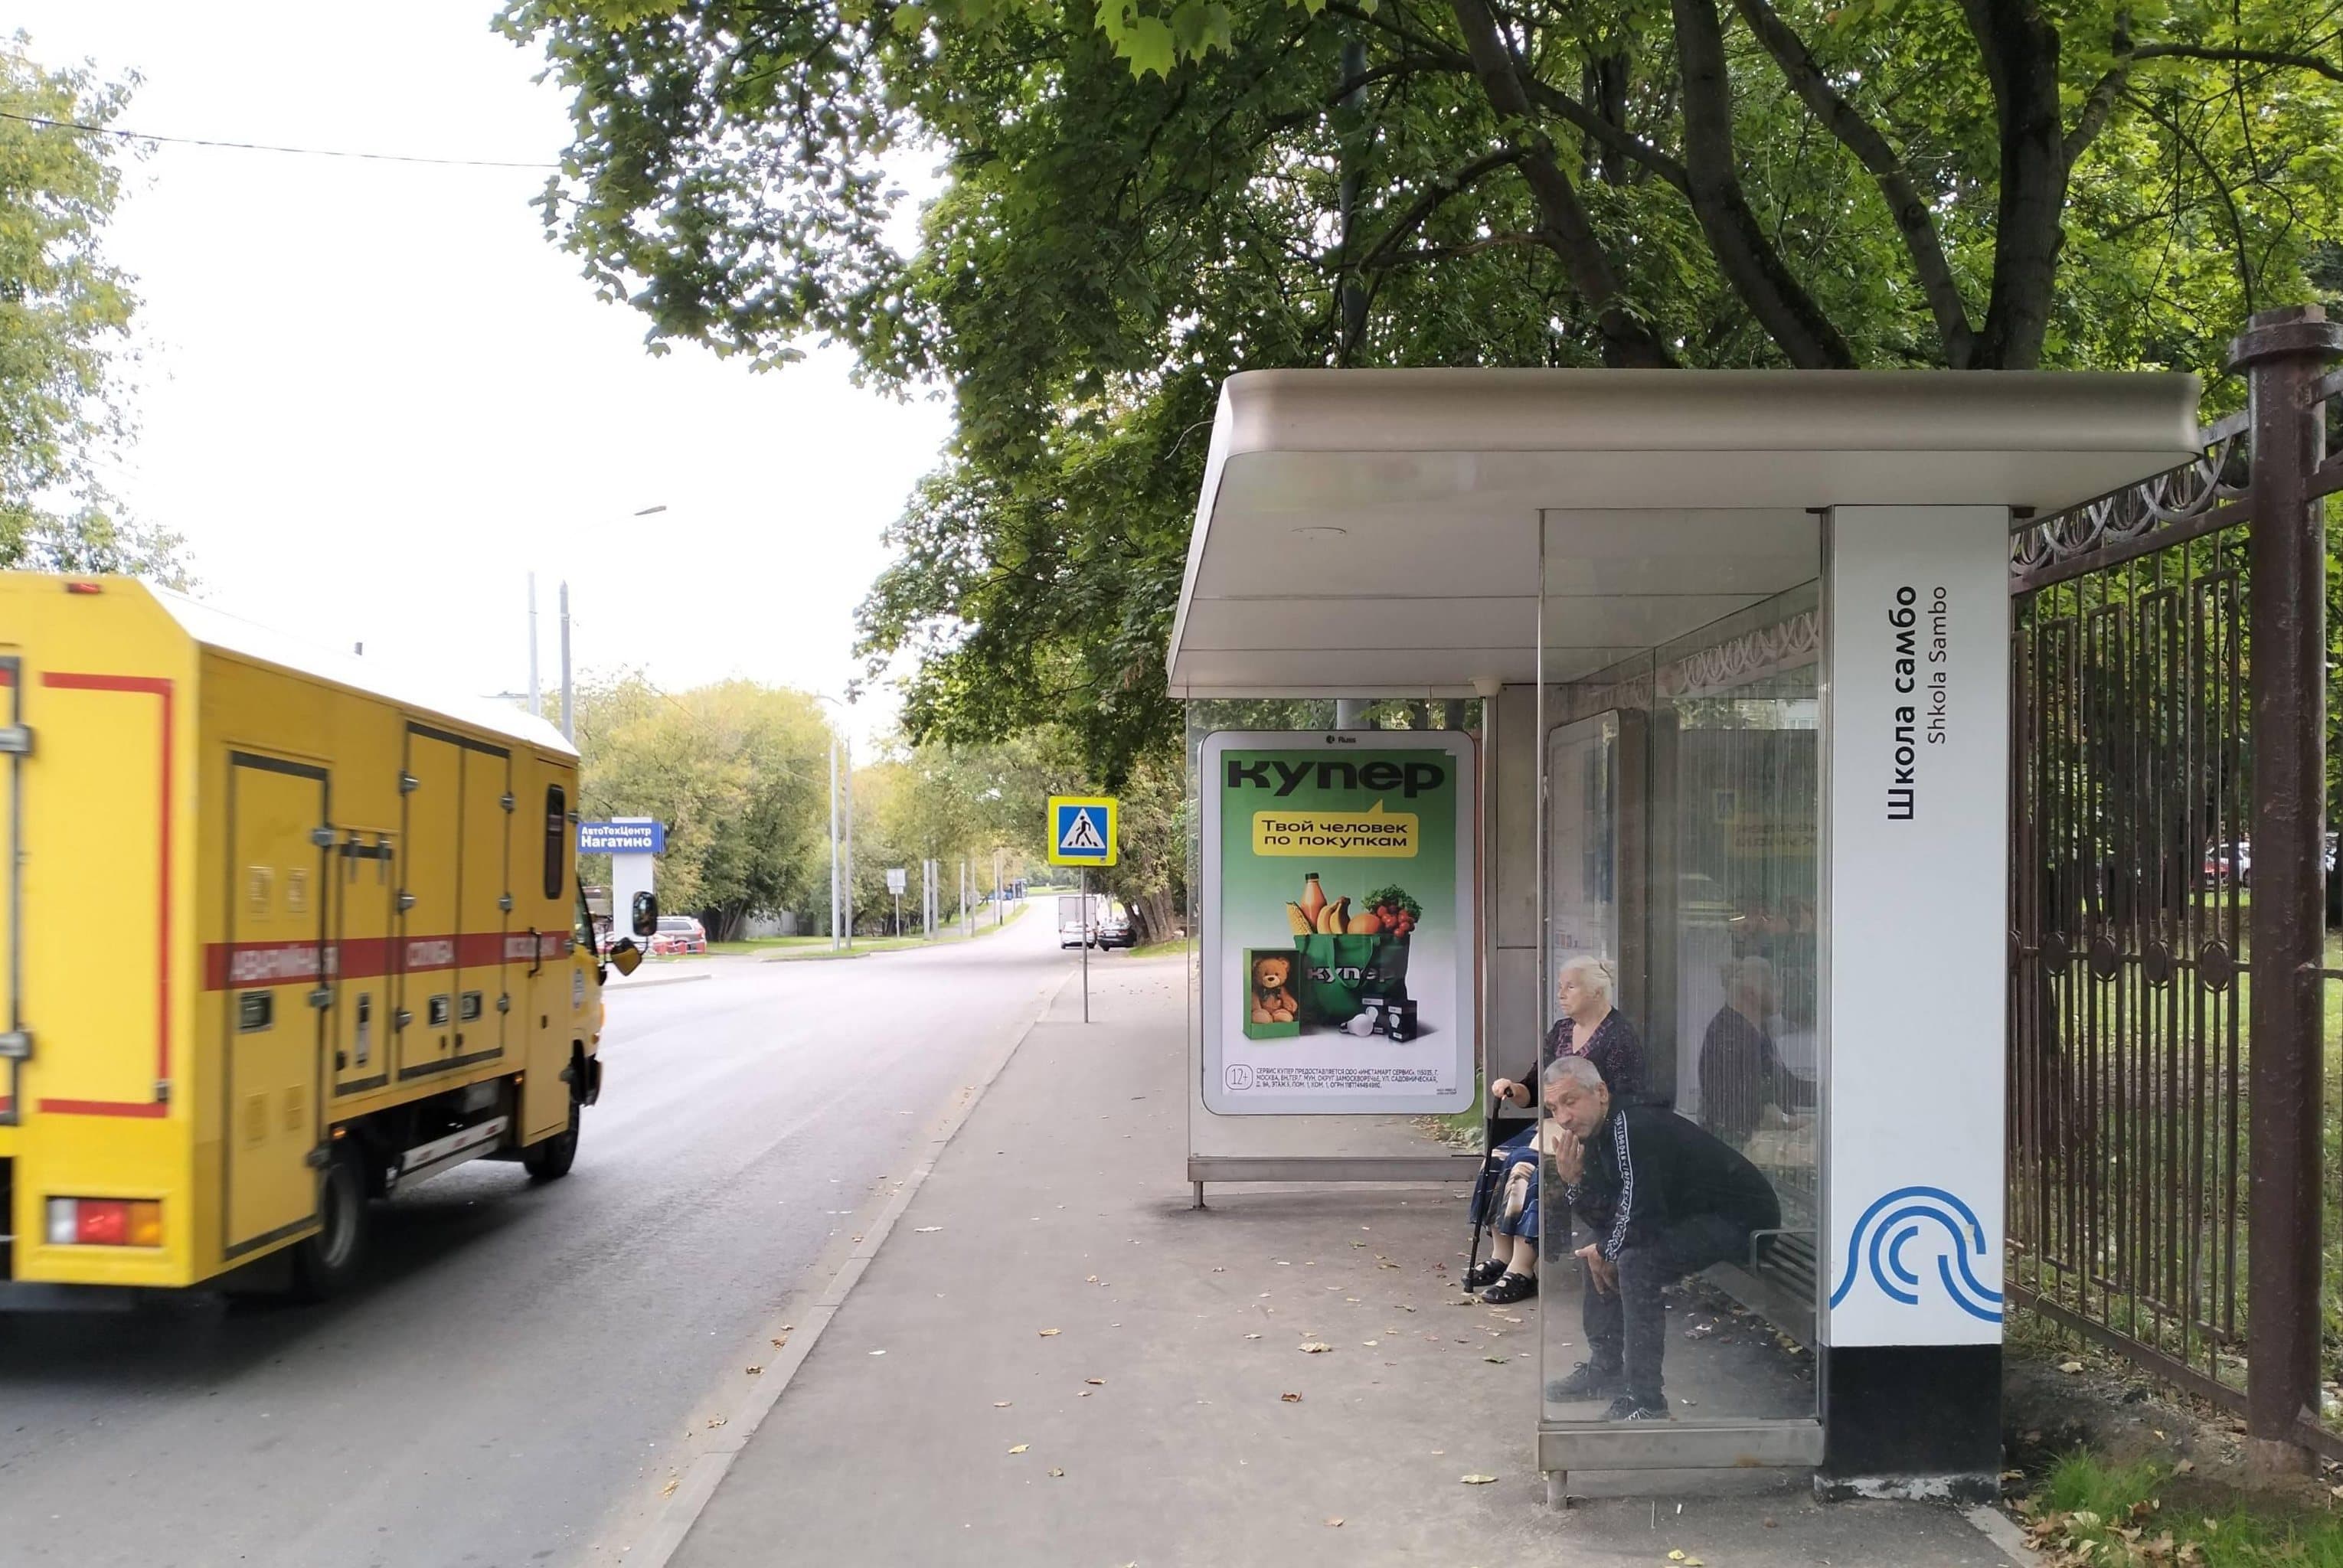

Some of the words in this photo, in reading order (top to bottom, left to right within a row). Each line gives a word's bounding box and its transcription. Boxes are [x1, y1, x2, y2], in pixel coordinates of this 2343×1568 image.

[1928, 586, 1947, 662] Sambo
[1888, 586, 1917, 694] самбо
[1927, 671, 1946, 744] Shkola
[1887, 706, 1915, 820] Школа
[1227, 760, 1445, 798] купер
[581, 826, 652, 837] АвтоТехЦентр
[1262, 819, 1314, 833] Твой
[1319, 823, 1408, 834] человек
[581, 835, 652, 848] Нагатино
[1264, 835, 1290, 846] по
[1299, 836, 1407, 848] покупкам
[1230, 1068, 1248, 1085] 12+
